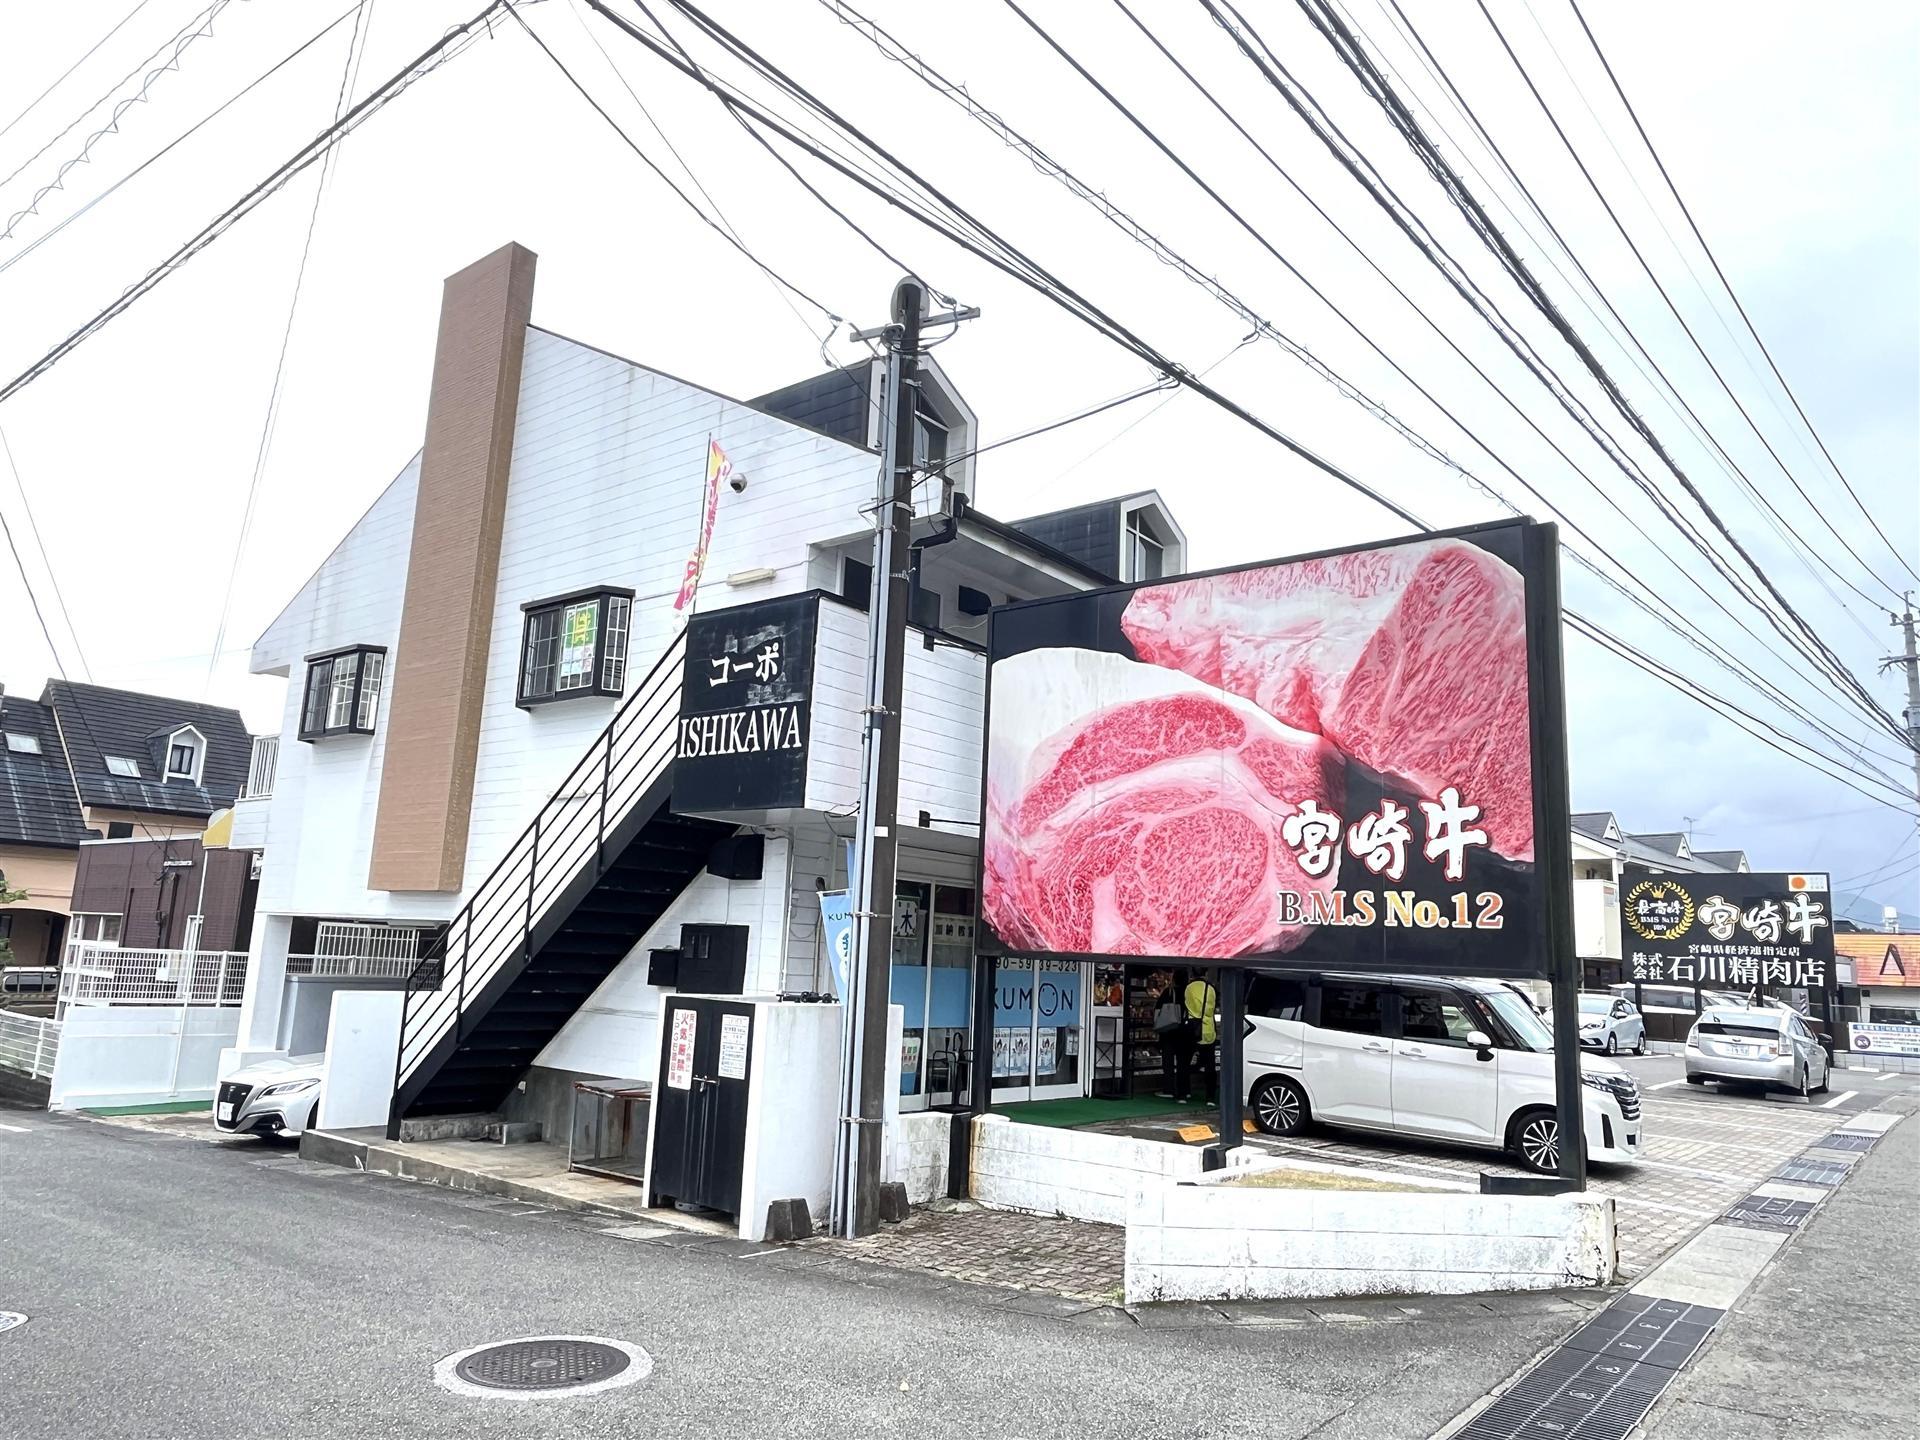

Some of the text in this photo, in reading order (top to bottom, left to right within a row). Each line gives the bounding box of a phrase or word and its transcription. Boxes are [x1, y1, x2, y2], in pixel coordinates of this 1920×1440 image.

[709, 642, 780, 688] コーポ
[677, 705, 802, 758] ISHIKAWA
[1281, 785, 1490, 881] 宮崎牛
[1277, 890, 1505, 930] B.M.S No.12
[1697, 892, 1829, 944] 宮崎牛
[1667, 955, 1826, 988] 石川精肉店
